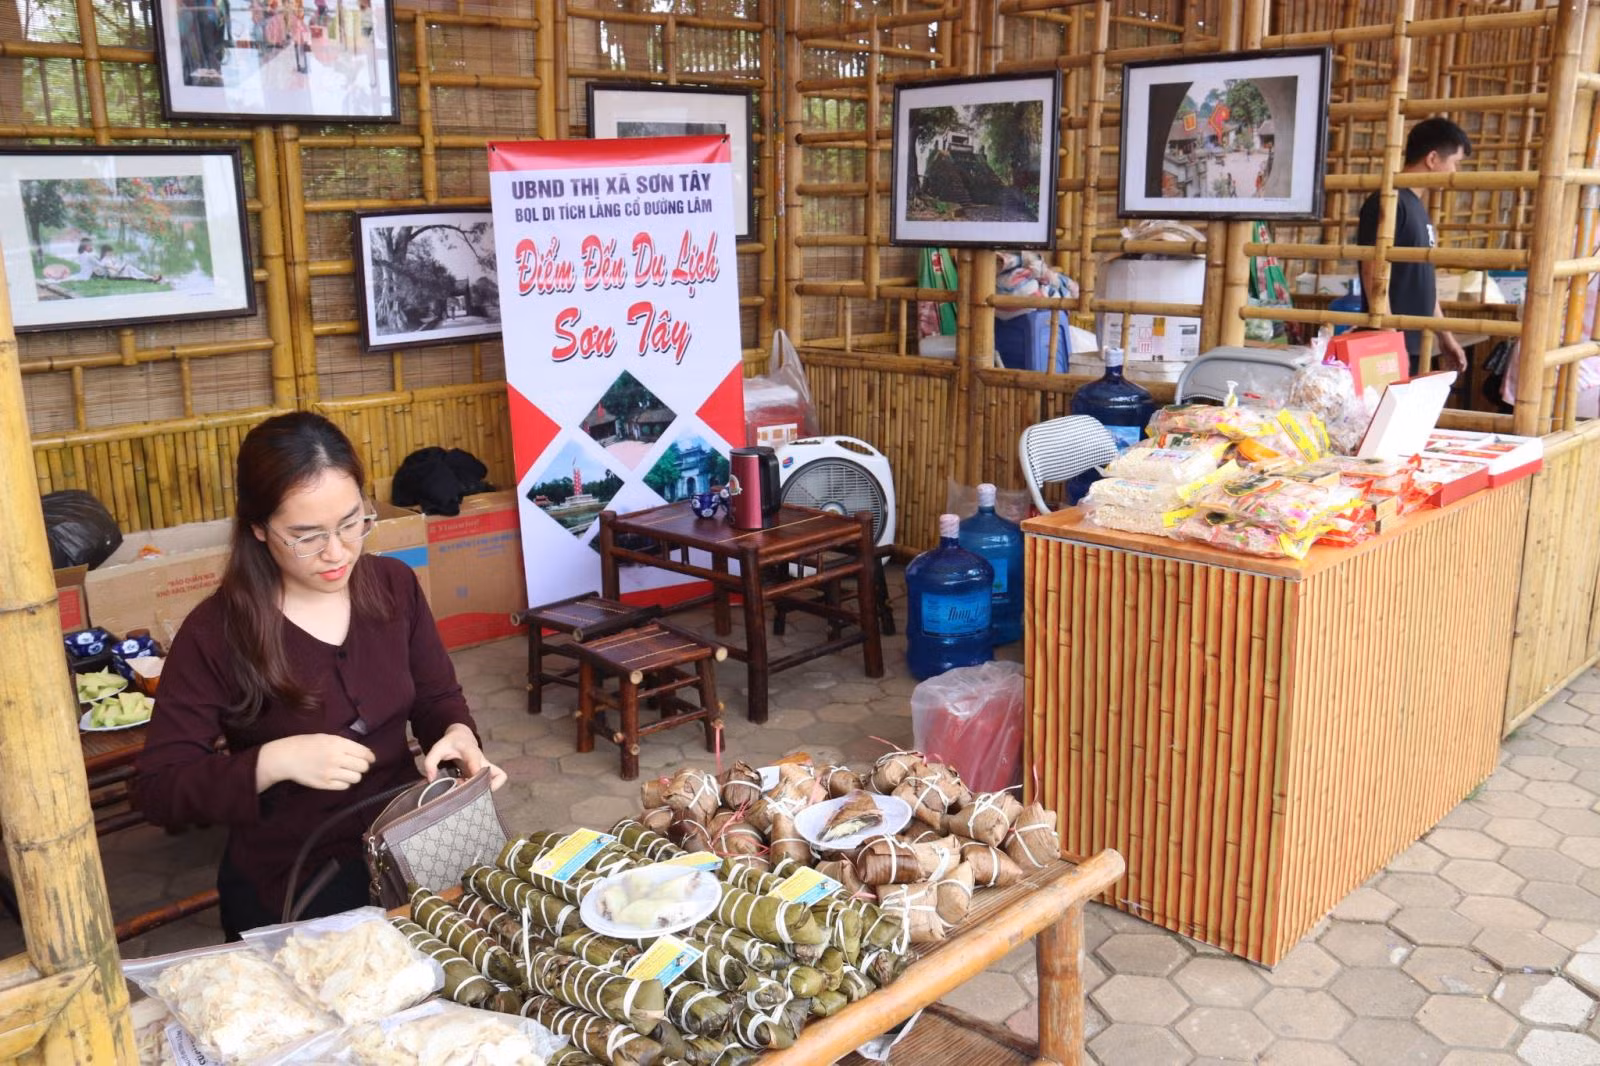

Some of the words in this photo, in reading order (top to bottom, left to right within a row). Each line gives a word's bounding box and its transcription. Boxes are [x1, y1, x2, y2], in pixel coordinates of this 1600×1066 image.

[512, 179, 565, 200] UBND
[570, 177, 600, 200] THỊ
[606, 173, 631, 195] XÃ
[636, 173, 674, 194] SƠN
[680, 170, 711, 192] TÂY
[515, 207, 540, 223] BQL
[542, 206, 555, 221] DI
[559, 202, 586, 220] TÍCH
[589, 200, 621, 219] LÀNG
[625, 196, 641, 217] CỔ
[644, 197, 684, 216] ĐƯỜNG
[687, 196, 712, 214] LÂM
[515, 236, 576, 296] Điểm
[580, 234, 627, 291] Đến
[631, 230, 667, 288] Du
[670, 228, 720, 298] Lịch
[551, 306, 617, 362] Sơn
[627, 301, 692, 365] Tây
